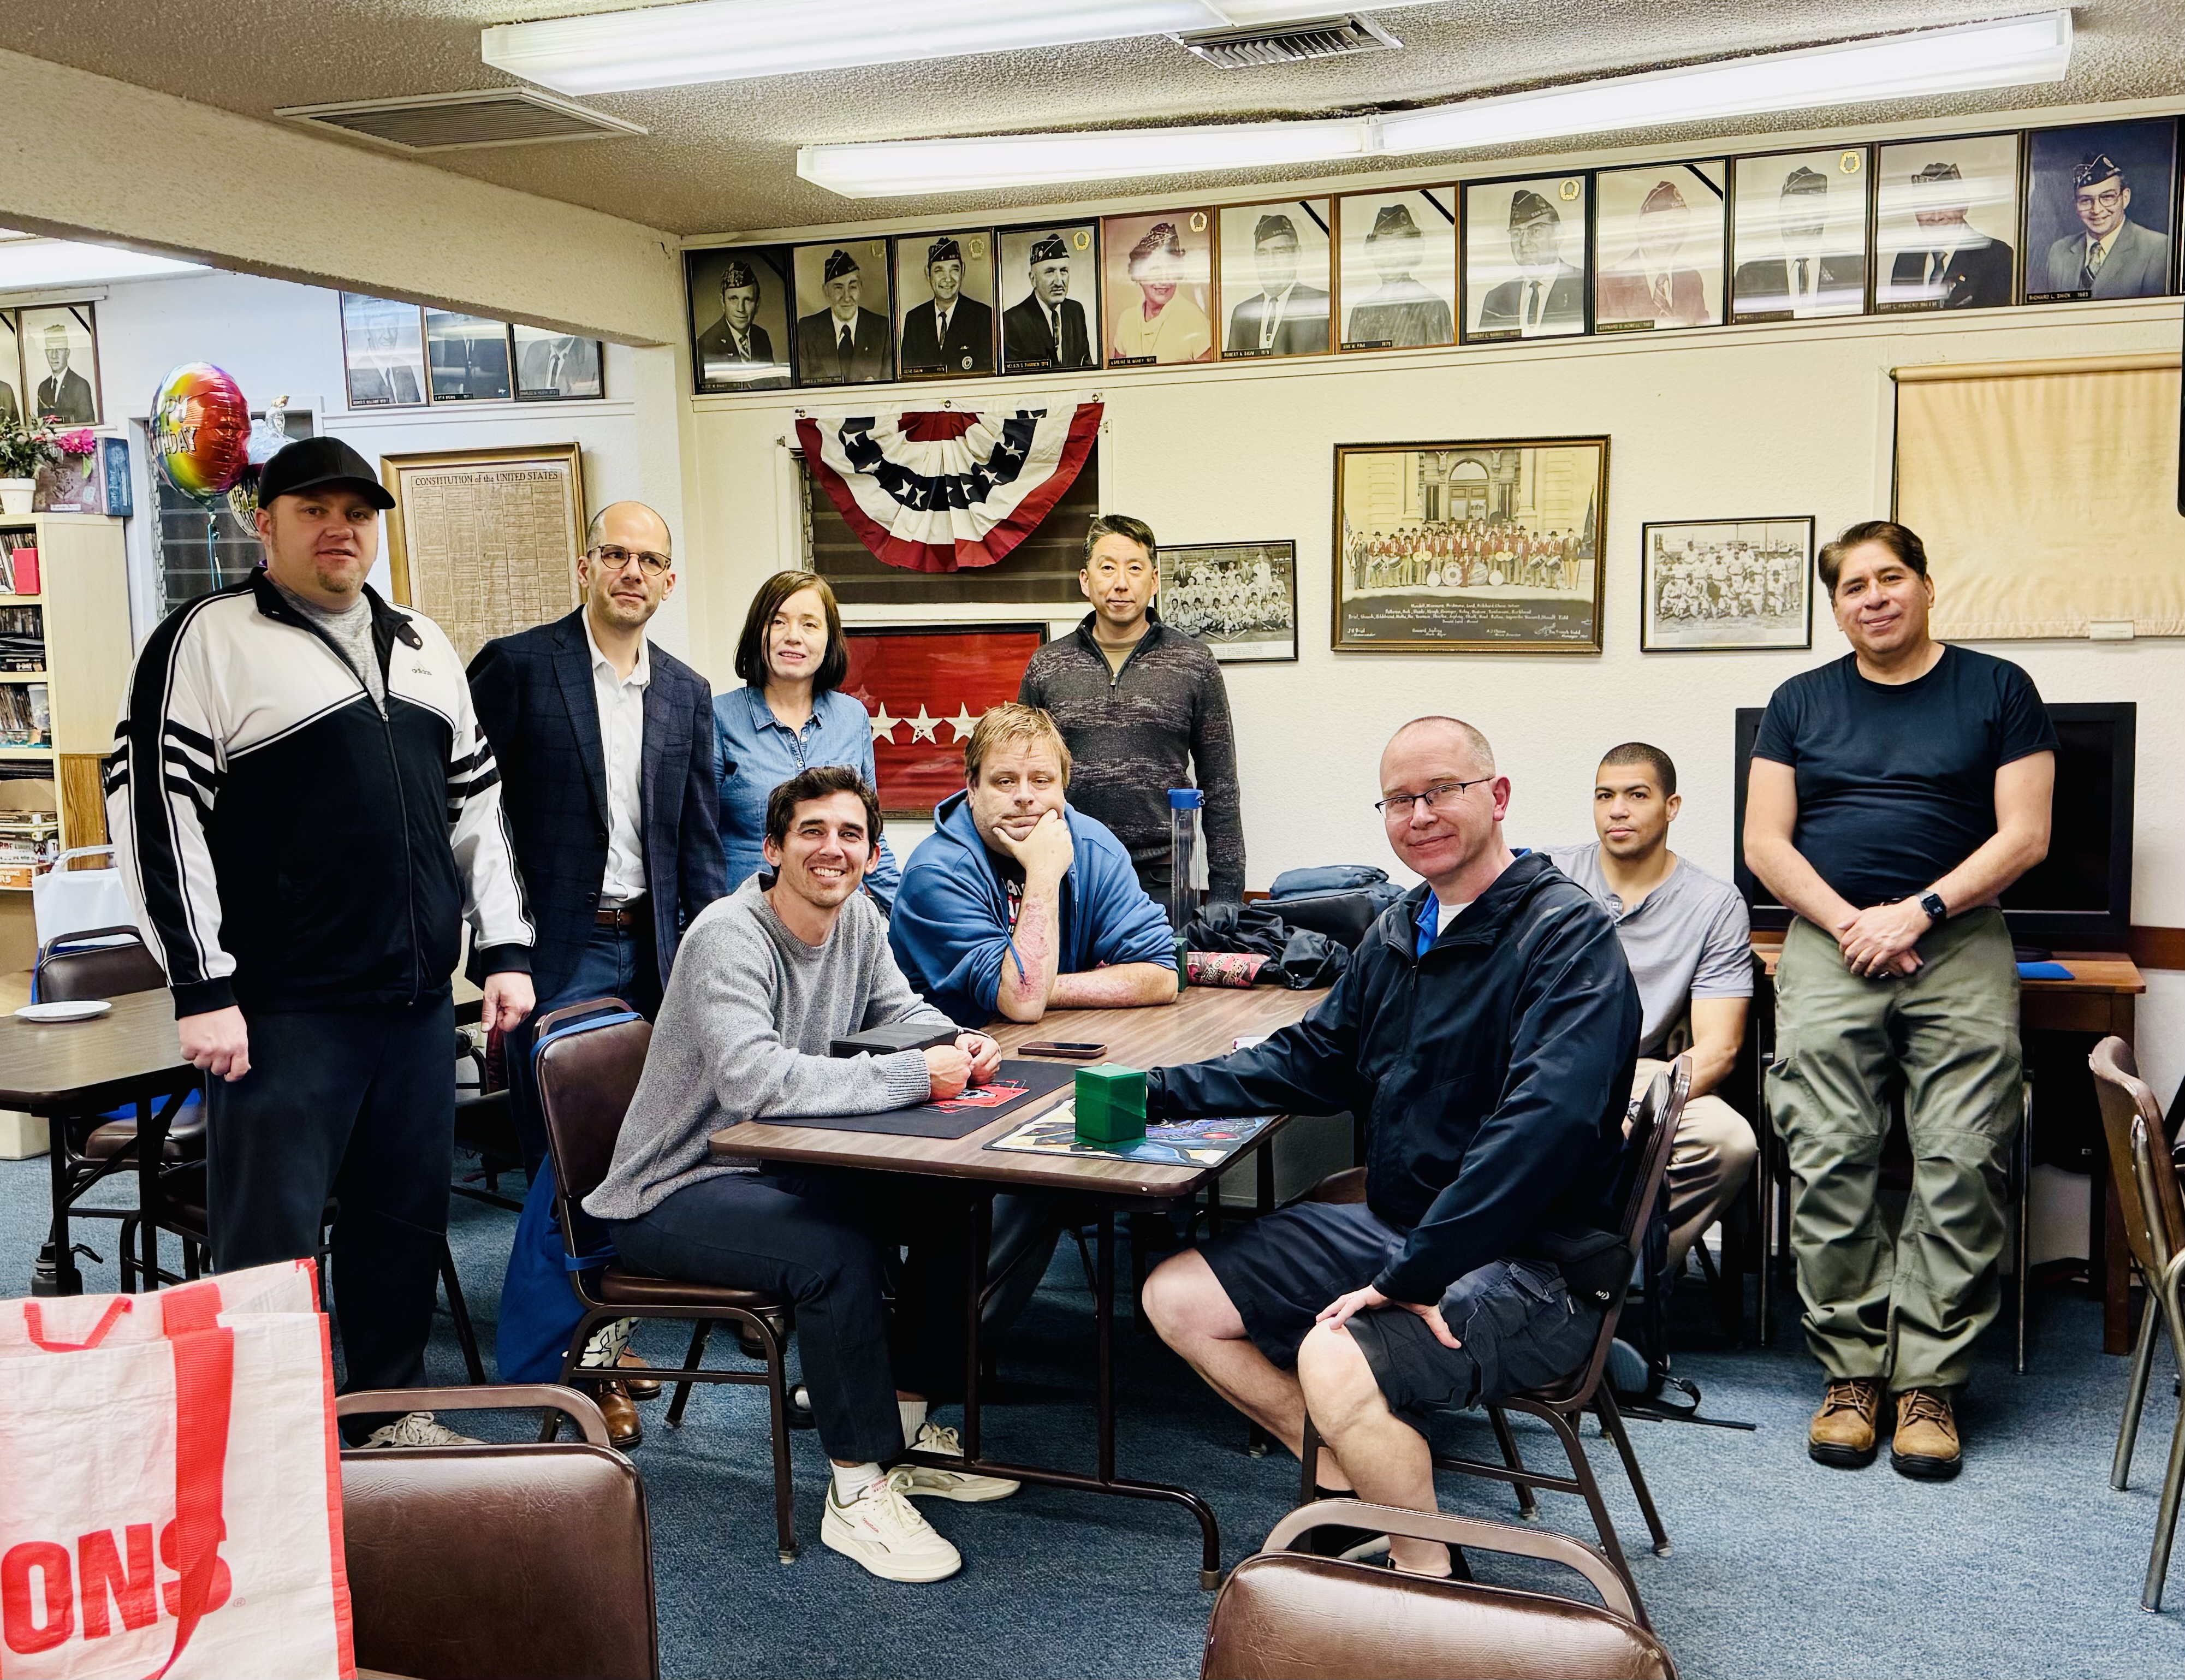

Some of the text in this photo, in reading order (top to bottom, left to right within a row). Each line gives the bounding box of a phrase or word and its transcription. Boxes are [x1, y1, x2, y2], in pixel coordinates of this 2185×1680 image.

[415, 474, 473, 486] CONSTITUTION
[496, 472, 526, 482] UNITED
[527, 471, 558, 480] STATES
